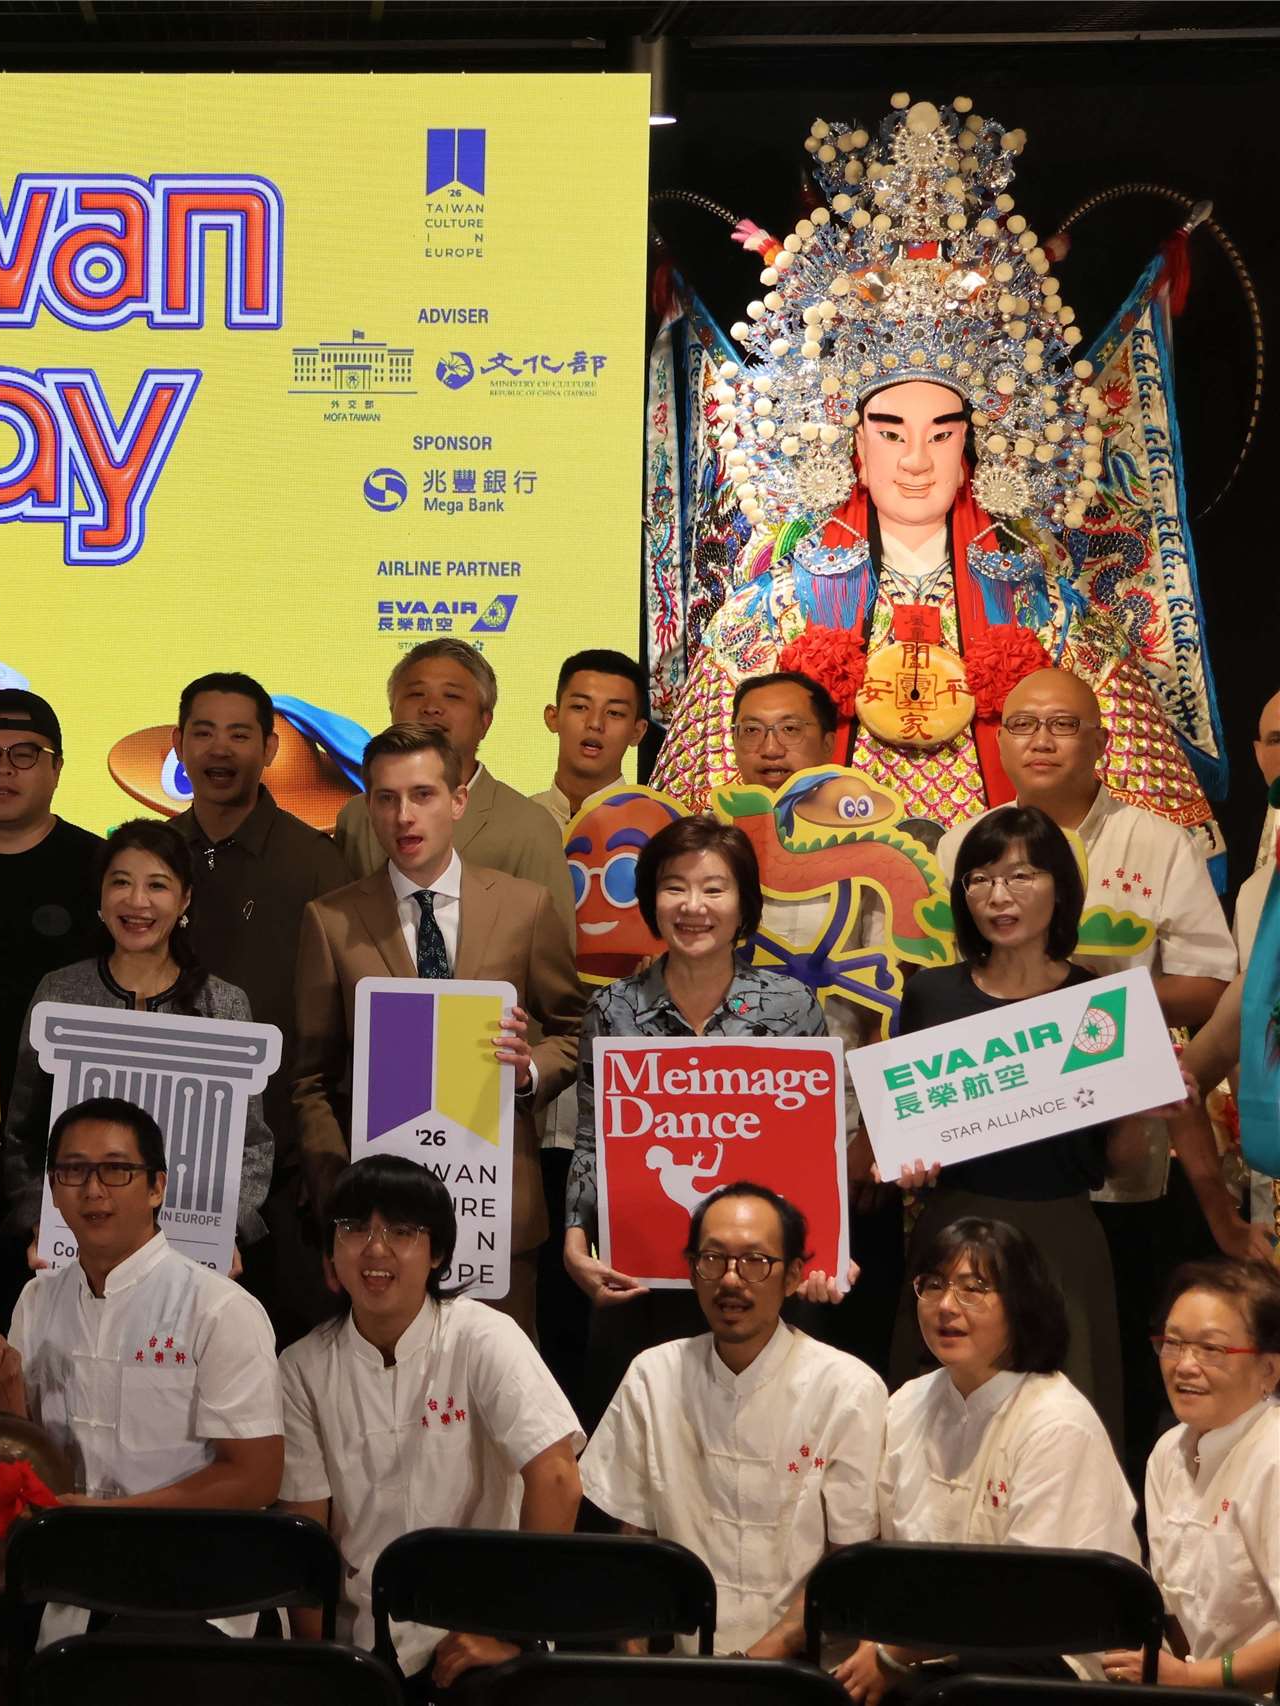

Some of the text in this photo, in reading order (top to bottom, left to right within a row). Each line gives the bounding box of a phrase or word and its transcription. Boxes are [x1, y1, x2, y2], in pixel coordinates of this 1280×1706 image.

[425, 203, 485, 213] TAIWAN
[424, 218, 484, 229] CULTURE
[424, 247, 484, 258] EUROPE
[417, 308, 489, 324] ADVISER
[479, 350, 608, 378] 文化部
[330, 399, 375, 410] 外交部
[323, 412, 381, 423] MOFA TAIWAN
[412, 435, 493, 451] SPONSOR
[422, 468, 538, 495] 兆豐銀行
[423, 497, 505, 516] Mega Bank
[376, 560, 521, 577] AIRLINE PARTNER
[377, 616, 453, 632] 長榮航空
[882, 1020, 1065, 1092] EVA AIR
[605, 1052, 831, 1111] Meimage
[894, 1063, 1030, 1121] 長榮航空
[606, 1095, 762, 1140] Dance
[939, 1098, 1069, 1144] STAR ALLIANCE
[415, 1129, 447, 1147] '26
[424, 1163, 497, 1185] WAN
[160, 1210, 222, 1228] IN EUROPE
[439, 1263, 494, 1285] OPE
